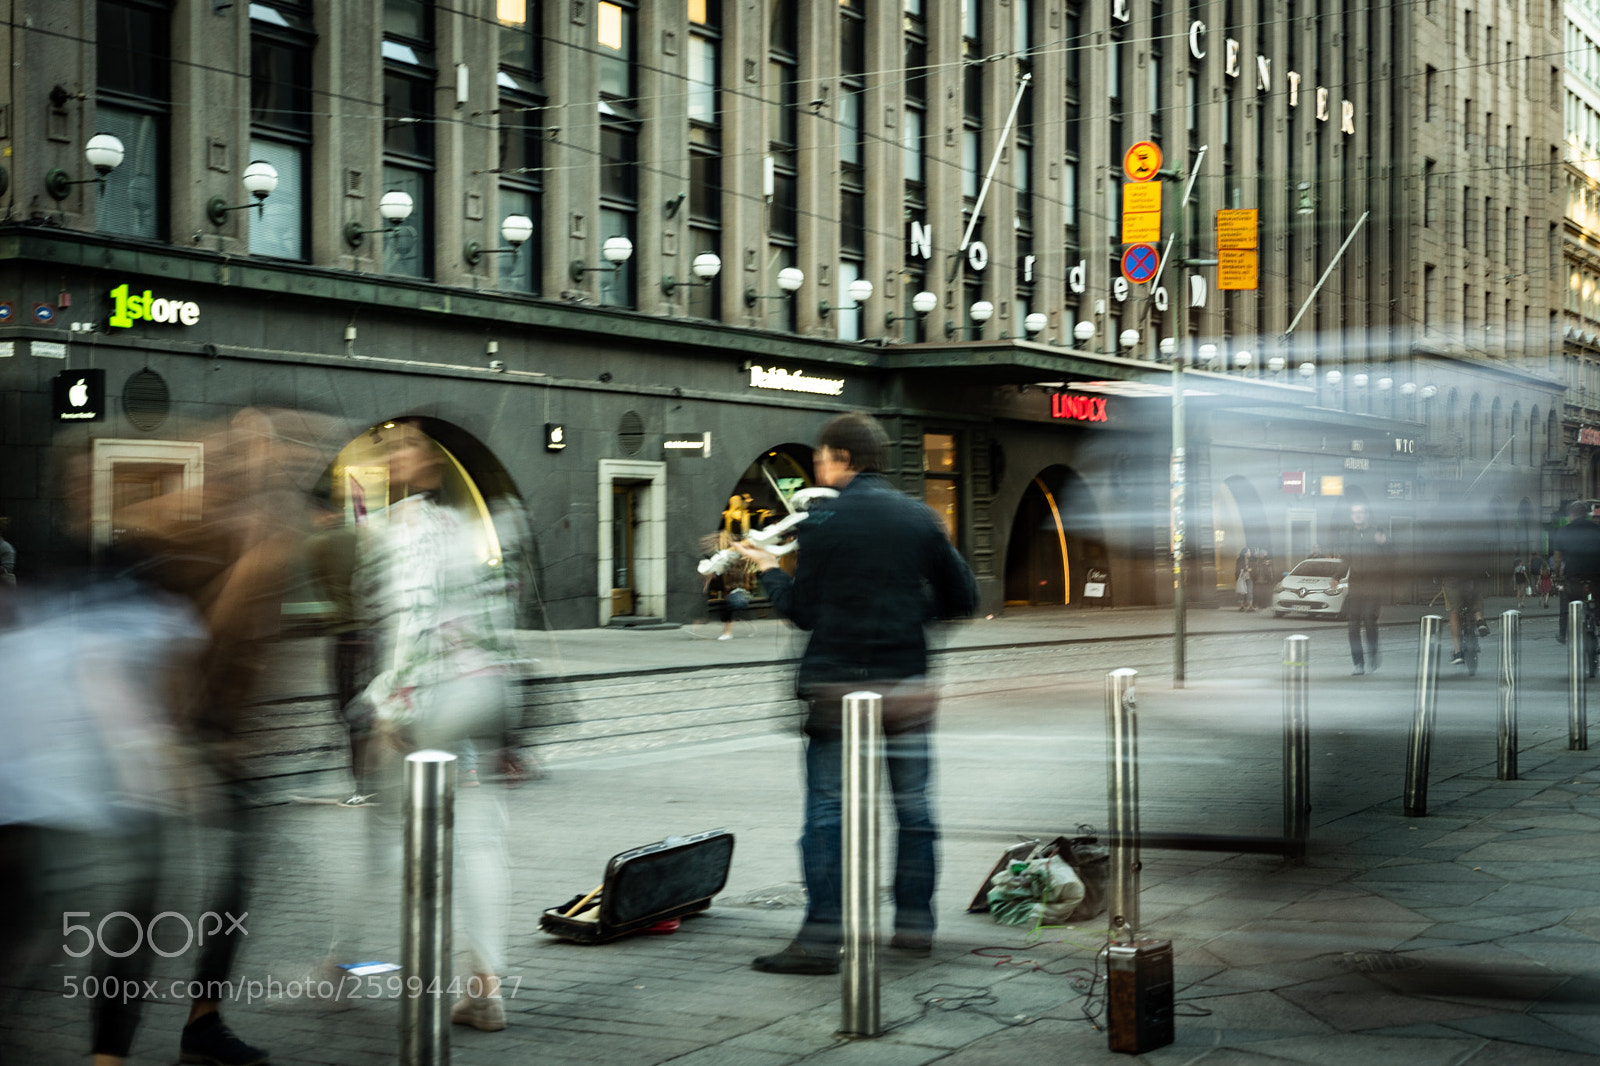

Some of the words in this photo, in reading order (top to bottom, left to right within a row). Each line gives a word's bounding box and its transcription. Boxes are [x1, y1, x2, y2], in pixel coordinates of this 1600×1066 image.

[1189, 20, 1355, 135] CENTER
[910, 220, 1169, 312] Nordea
[109, 283, 200, 329] 1store
[1395, 438, 1415, 454] WTC
